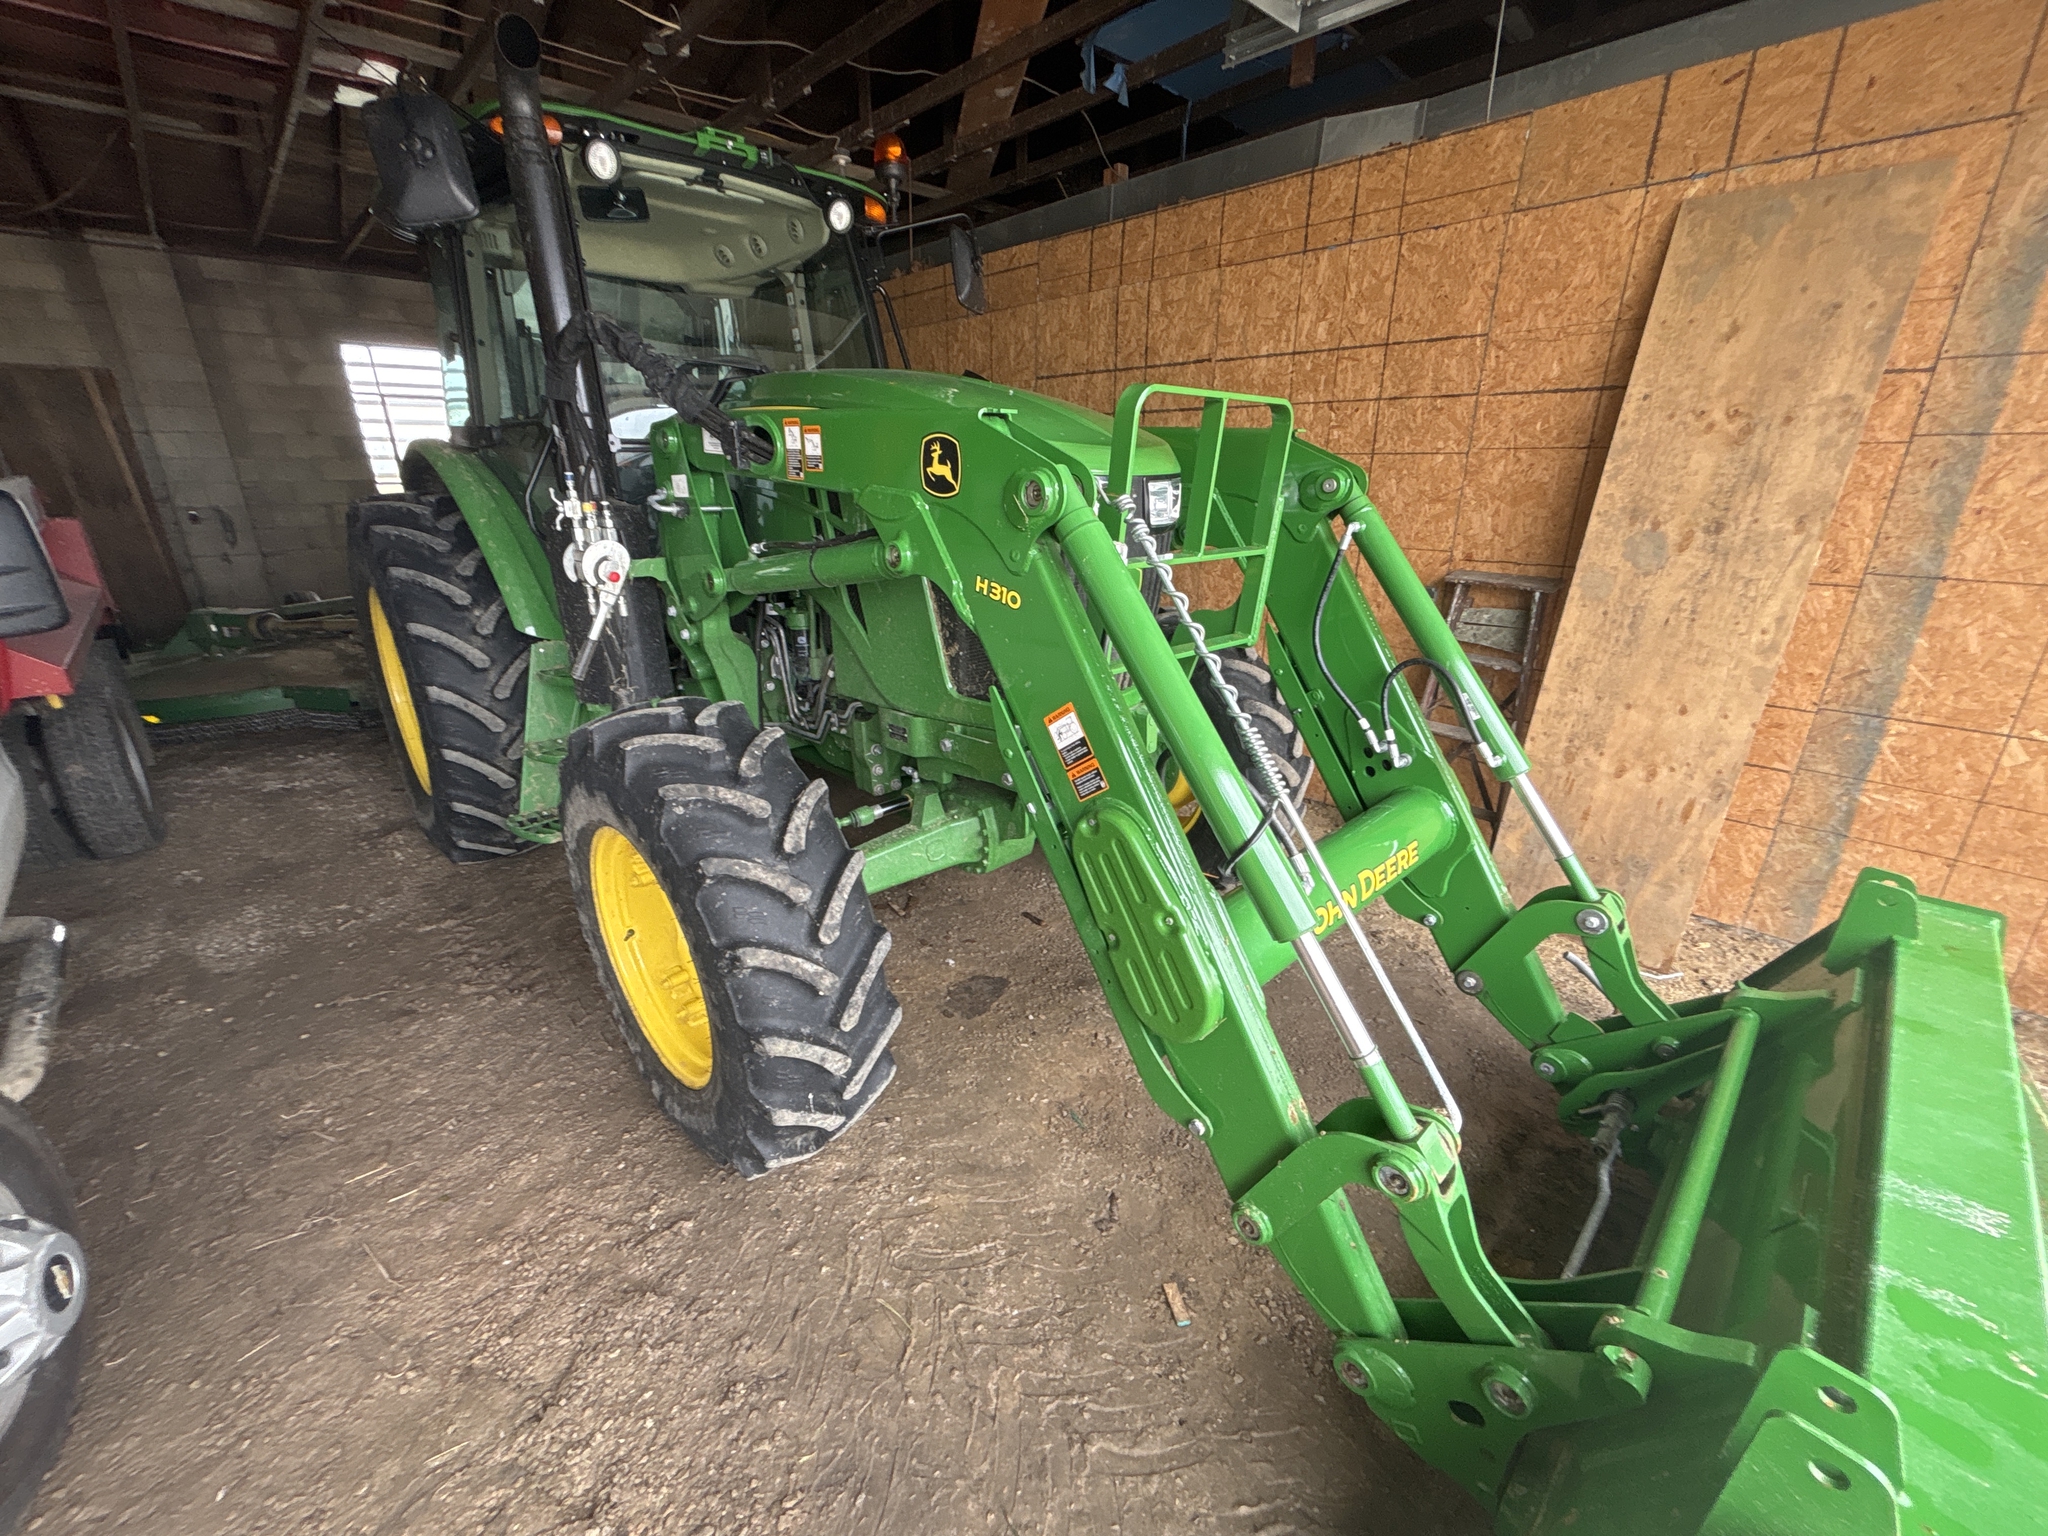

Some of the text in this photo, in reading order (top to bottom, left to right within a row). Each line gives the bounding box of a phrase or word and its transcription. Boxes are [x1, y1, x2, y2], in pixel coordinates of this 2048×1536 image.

[975, 575, 1021, 610] H310
[1314, 839, 1419, 935] OHN DEERE
